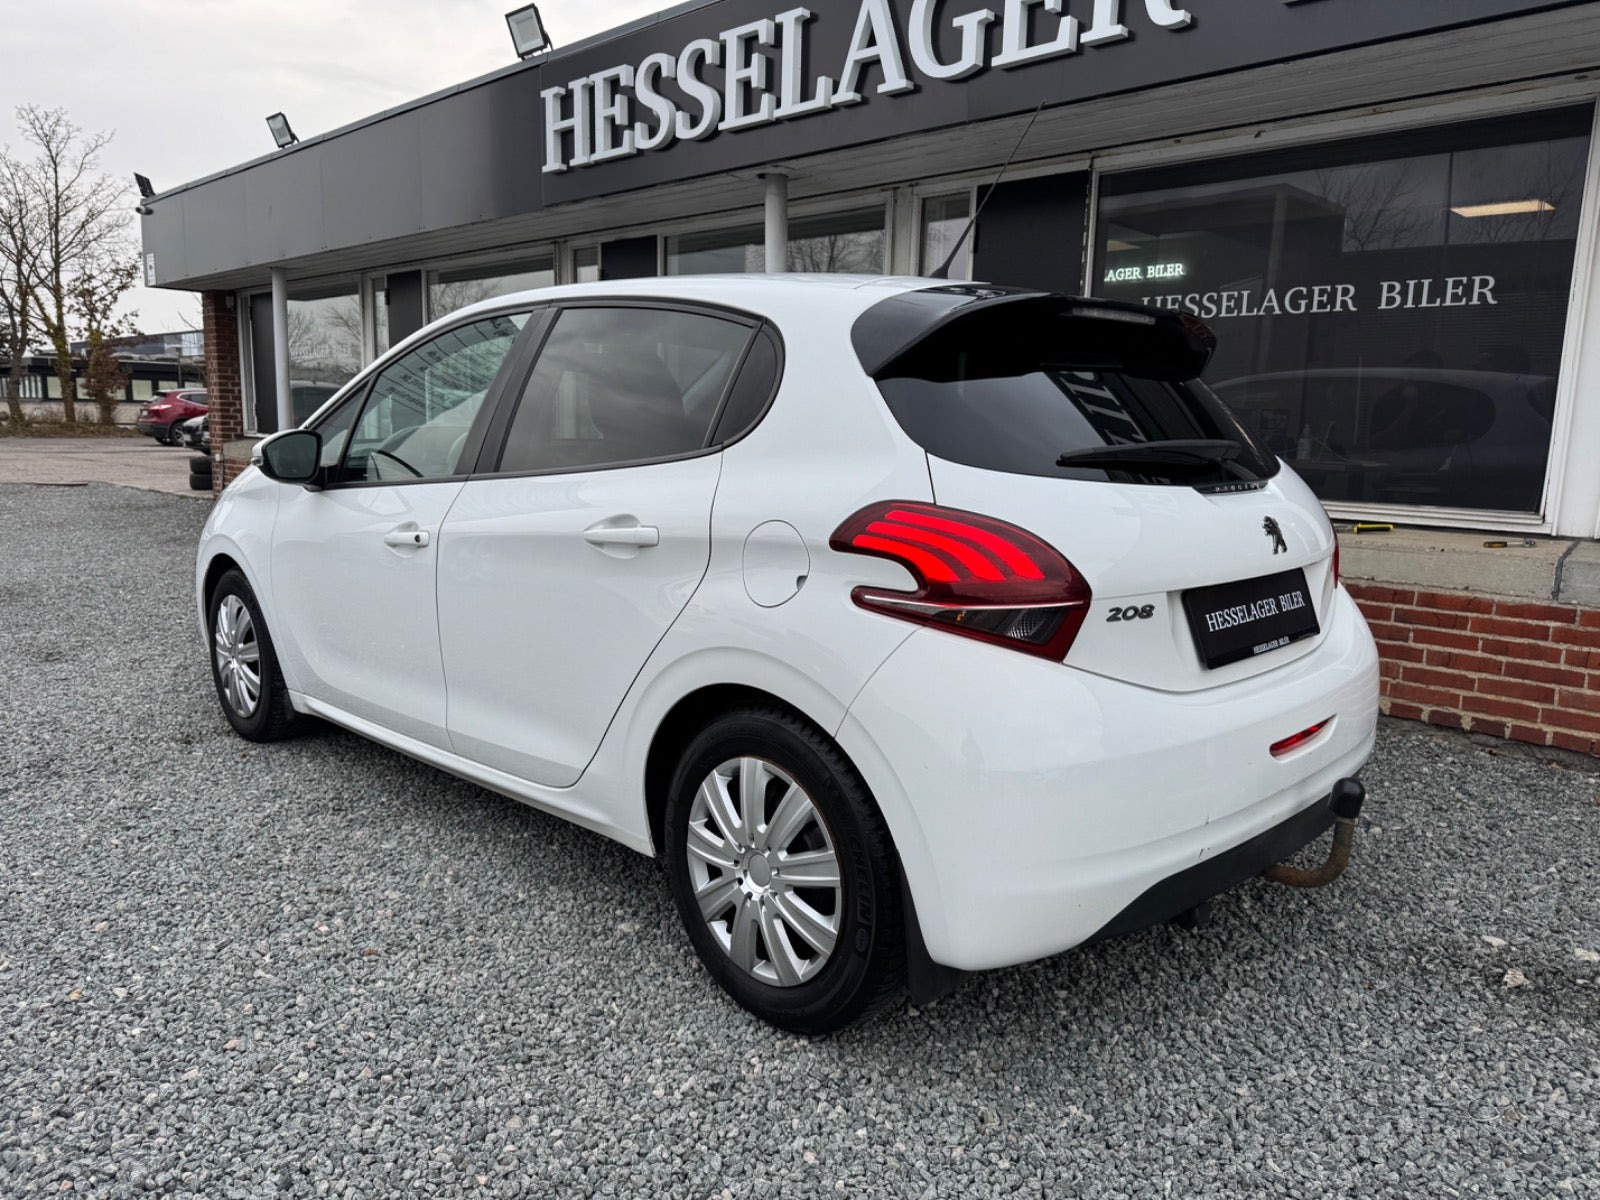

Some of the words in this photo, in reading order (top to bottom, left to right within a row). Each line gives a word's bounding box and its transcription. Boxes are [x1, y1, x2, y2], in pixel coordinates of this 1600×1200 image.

[1146, 263, 1185, 279] BILER
[1378, 275, 1498, 310] BILER
[1106, 604, 1155, 622] 208
[1205, 597, 1279, 632] HESSELAGER
[1278, 590, 1306, 612] BILER
